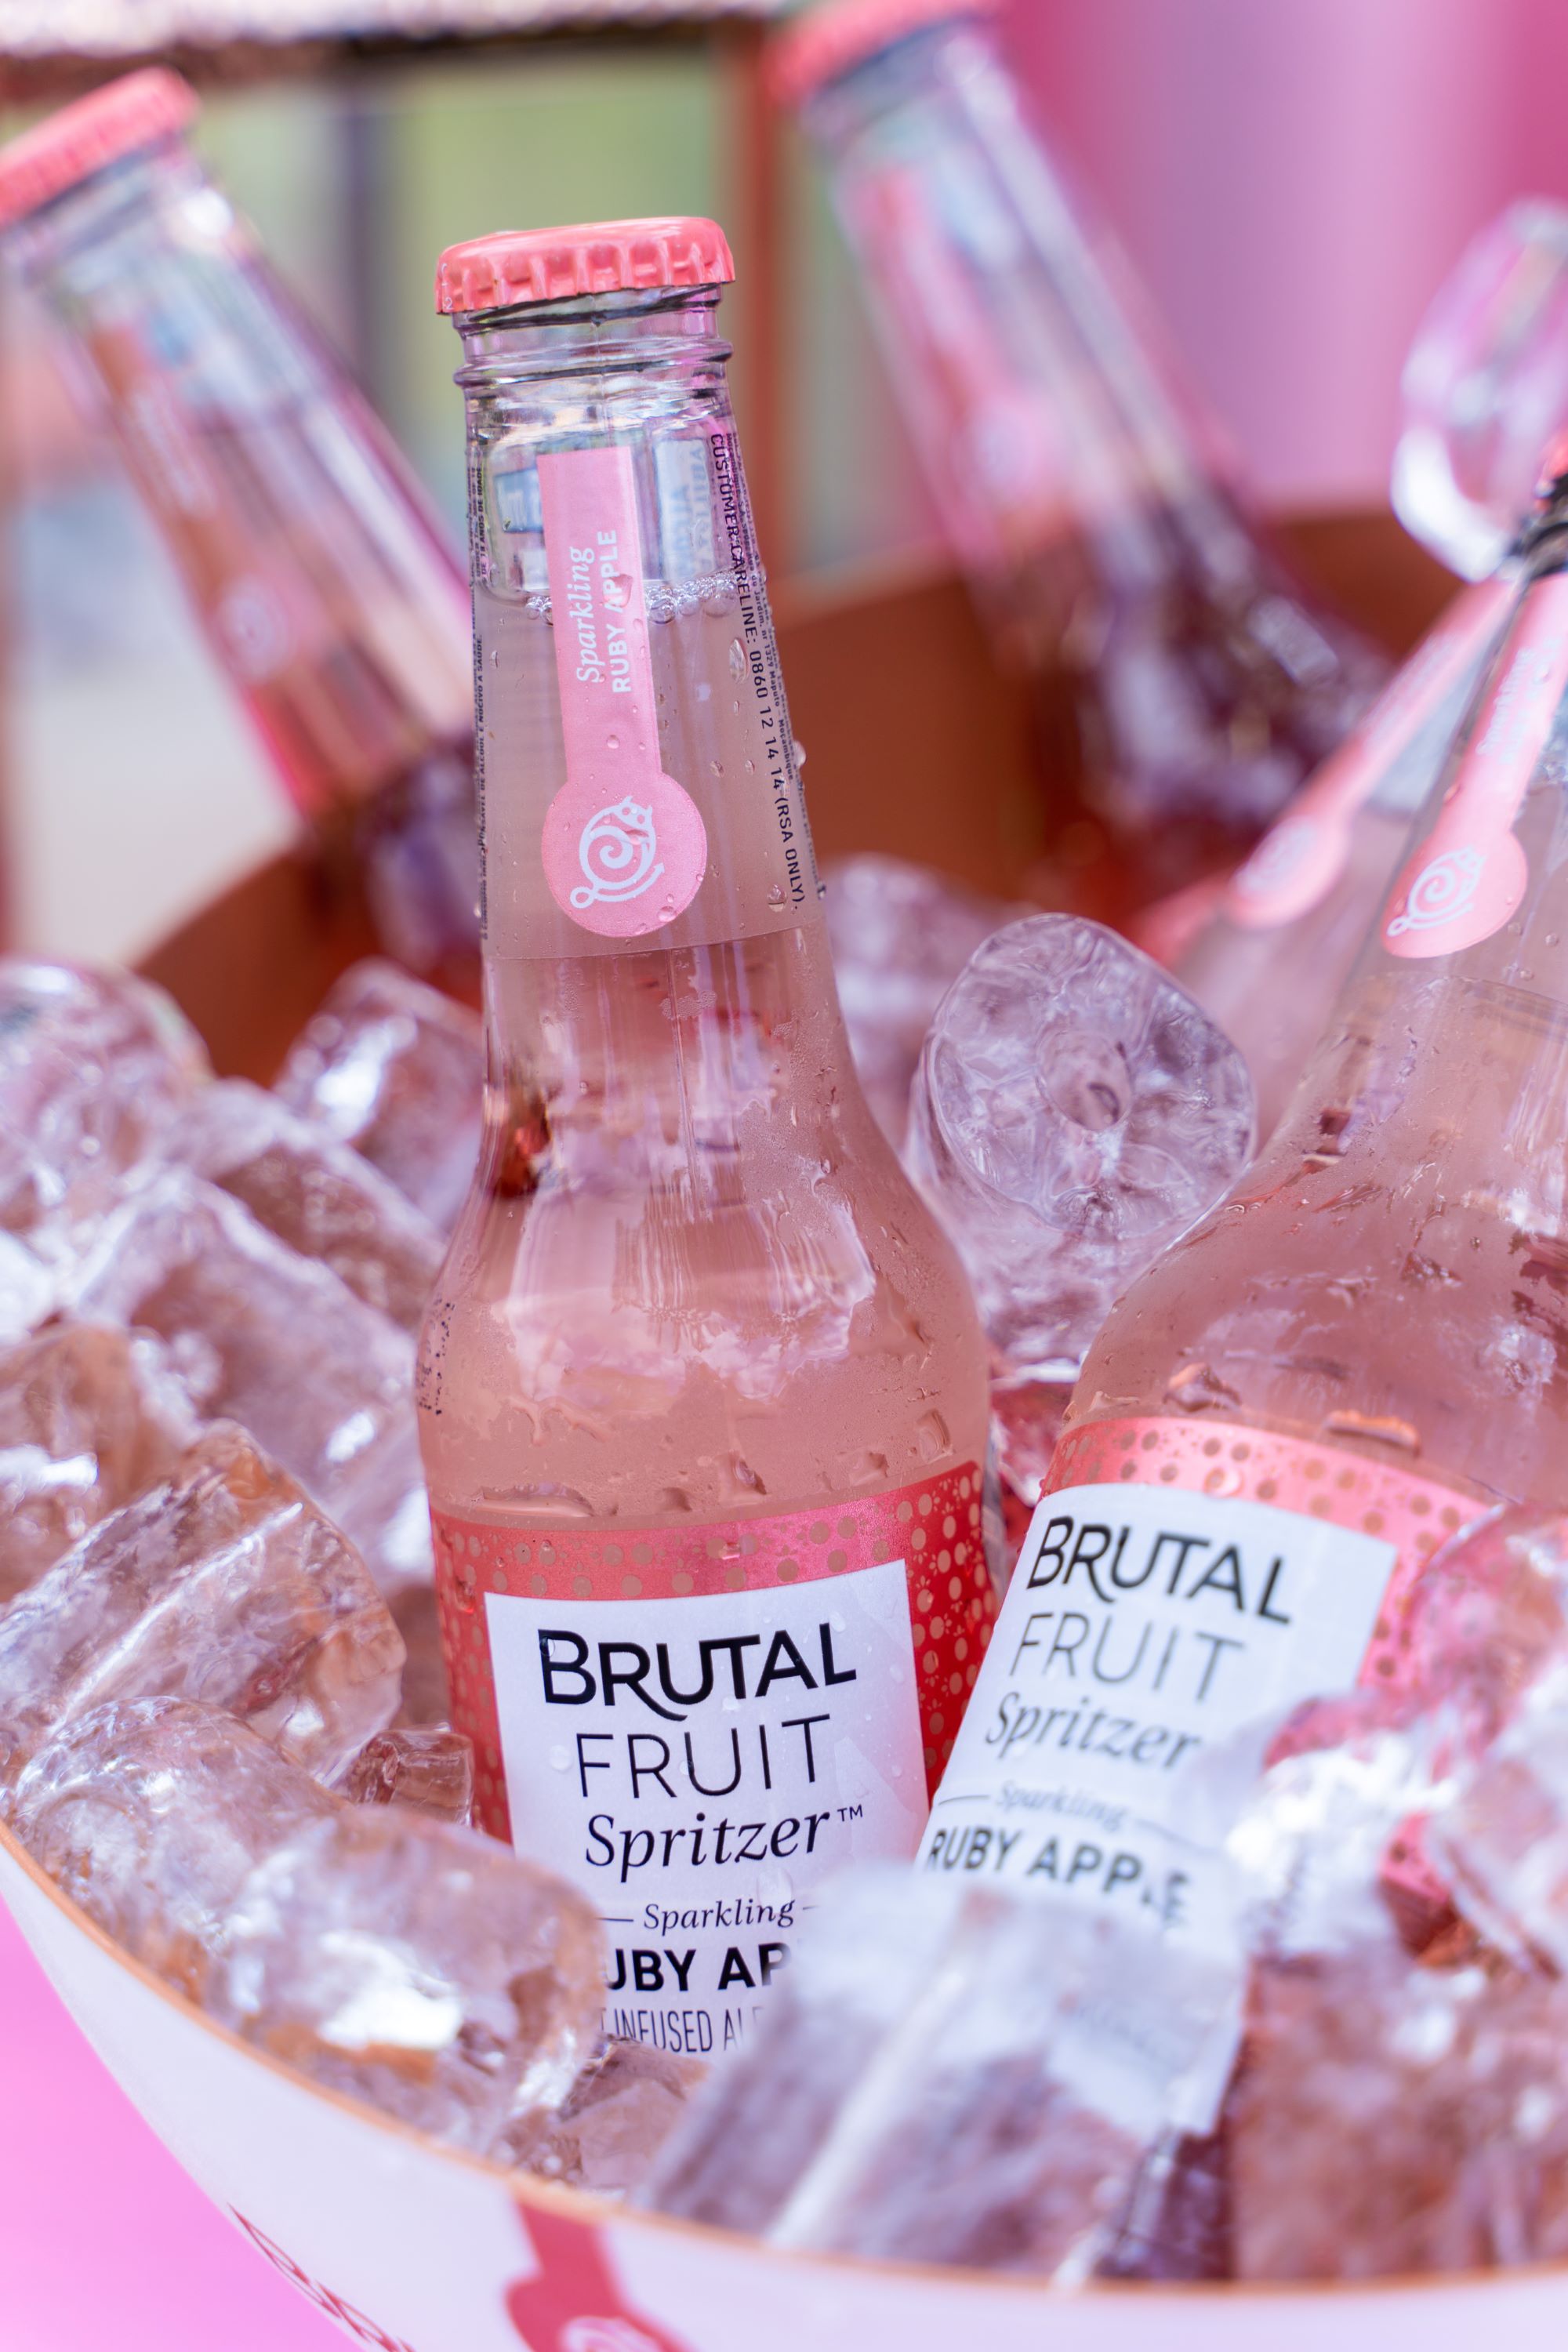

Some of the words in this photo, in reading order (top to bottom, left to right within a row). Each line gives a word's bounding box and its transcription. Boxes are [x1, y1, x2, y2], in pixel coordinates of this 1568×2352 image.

[710, 434, 740, 539] CUSTOMER
[597, 530, 624, 614] APPLE
[731, 543, 758, 644] CARELINE:
[567, 546, 606, 684] Sparkling
[606, 624, 632, 694] RUBY
[750, 651, 768, 698] 0860
[769, 670, 780, 707] Maputo
[760, 706, 774, 729] 12
[765, 737, 779, 760] 14
[771, 768, 785, 789] 14
[775, 797, 793, 843] (RSA
[786, 848, 805, 909] ONLY).
[1027, 1515, 1290, 1624] BRUTAL
[538, 1623, 857, 1722] BRUTAL
[1009, 1612, 1245, 1704] FRUIT
[576, 1714, 830, 1798] FRUIT
[985, 1691, 1202, 1770] Spritzer
[996, 1780, 1128, 1832] Sparkling
[926, 1826, 1022, 1871] RUBY
[644, 1899, 796, 1936] Sparkling
[604, 1948, 696, 1991] UBY
[614, 2009, 713, 2053] INFUSED
